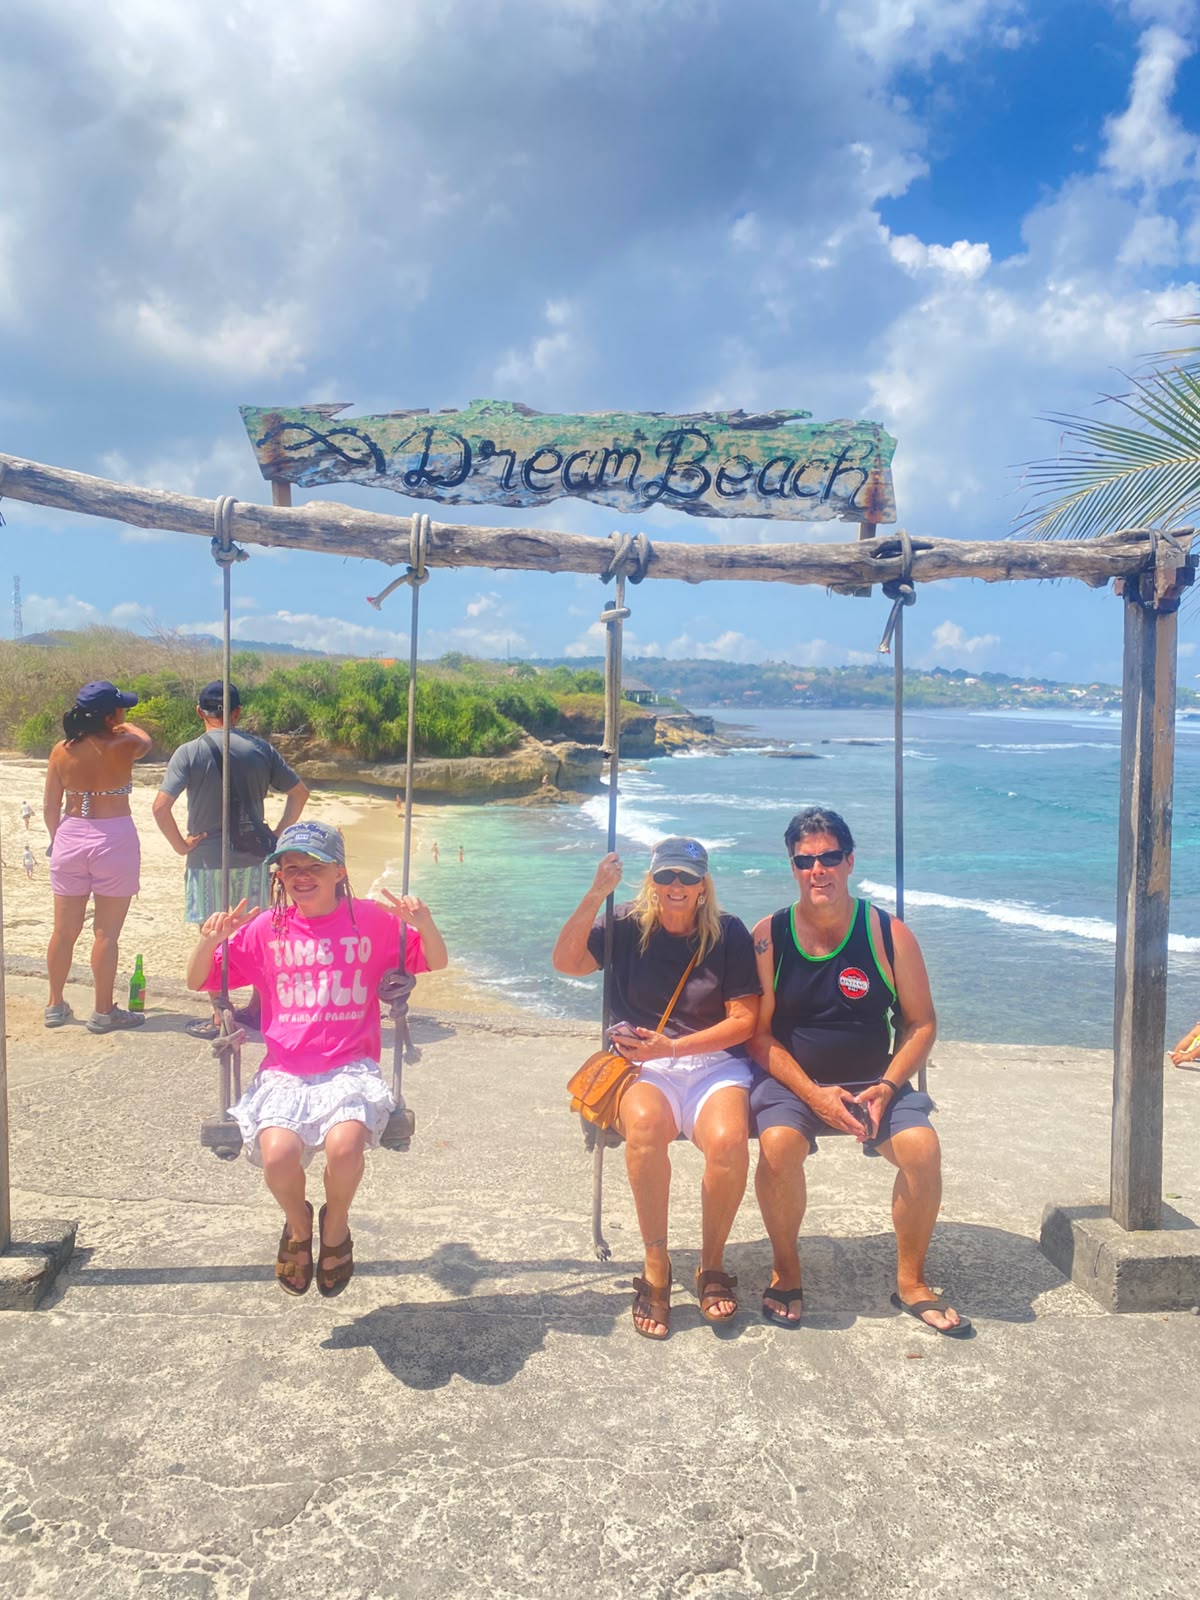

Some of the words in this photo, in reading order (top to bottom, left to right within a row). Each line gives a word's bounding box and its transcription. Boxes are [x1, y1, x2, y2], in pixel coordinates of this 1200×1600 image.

[391, 425, 642, 495] Dream
[640, 424, 874, 512] Beach
[267, 937, 334, 968] TIME
[339, 936, 372, 964] TO
[276, 969, 368, 1008] CHILL
[840, 977, 867, 989] BINTANG
[278, 1013, 290, 1023] MY
